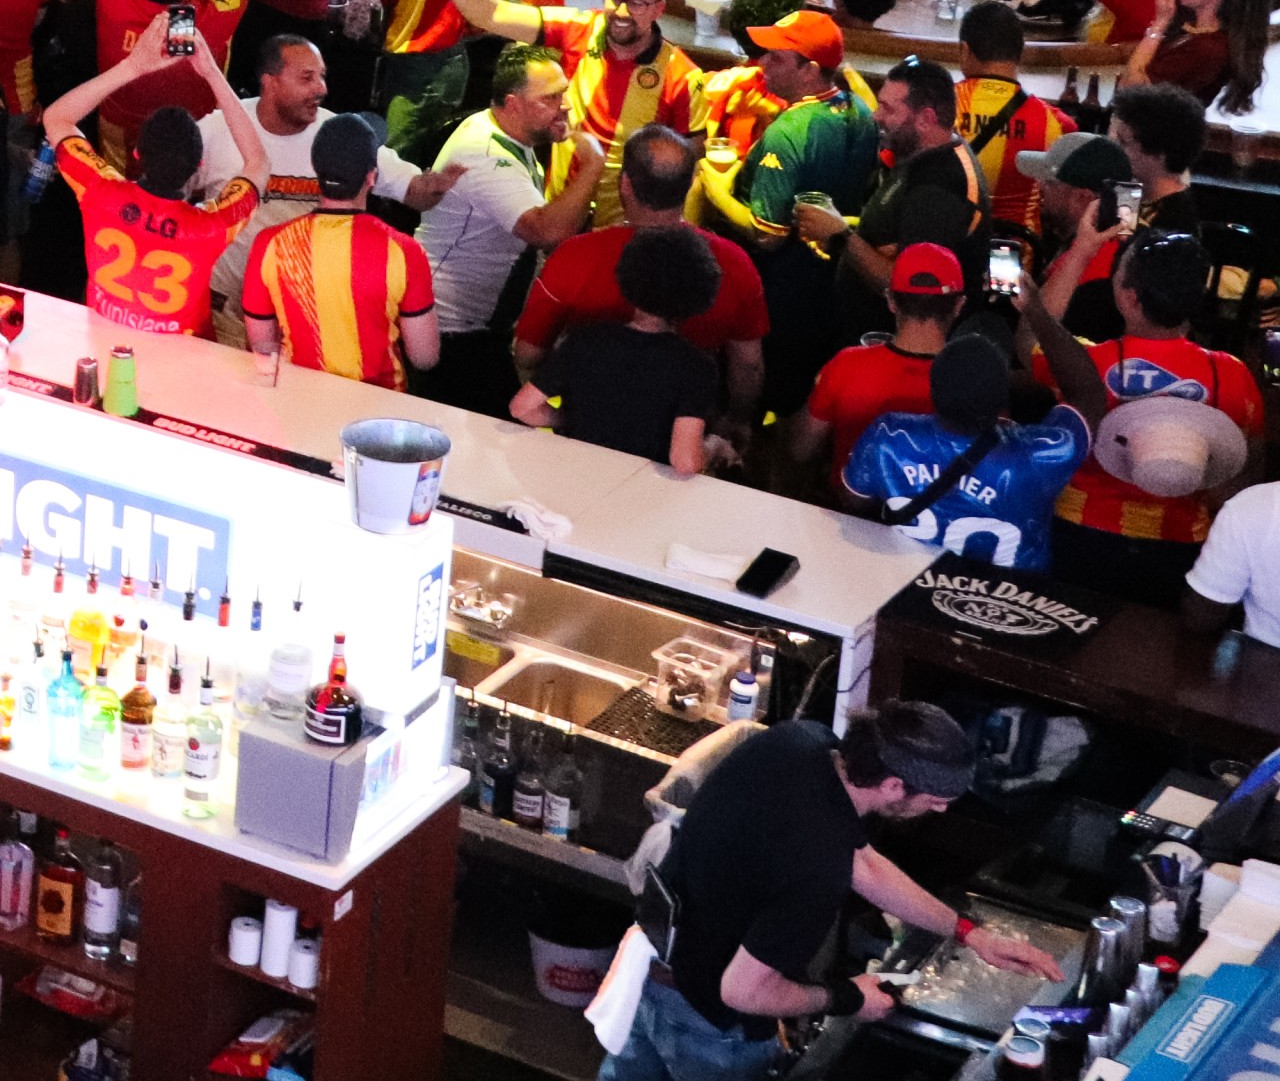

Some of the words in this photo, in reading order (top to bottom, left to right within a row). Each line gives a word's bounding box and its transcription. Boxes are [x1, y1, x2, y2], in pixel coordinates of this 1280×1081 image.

[960, 112, 1027, 139] ANAR
[145, 213, 178, 239] LG
[94, 228, 192, 314] 23
[193, 427, 256, 452] LIGHT
[903, 463, 997, 505] PAER
[915, 569, 990, 595] JACK
[991, 580, 1099, 634] DANIEL'S
